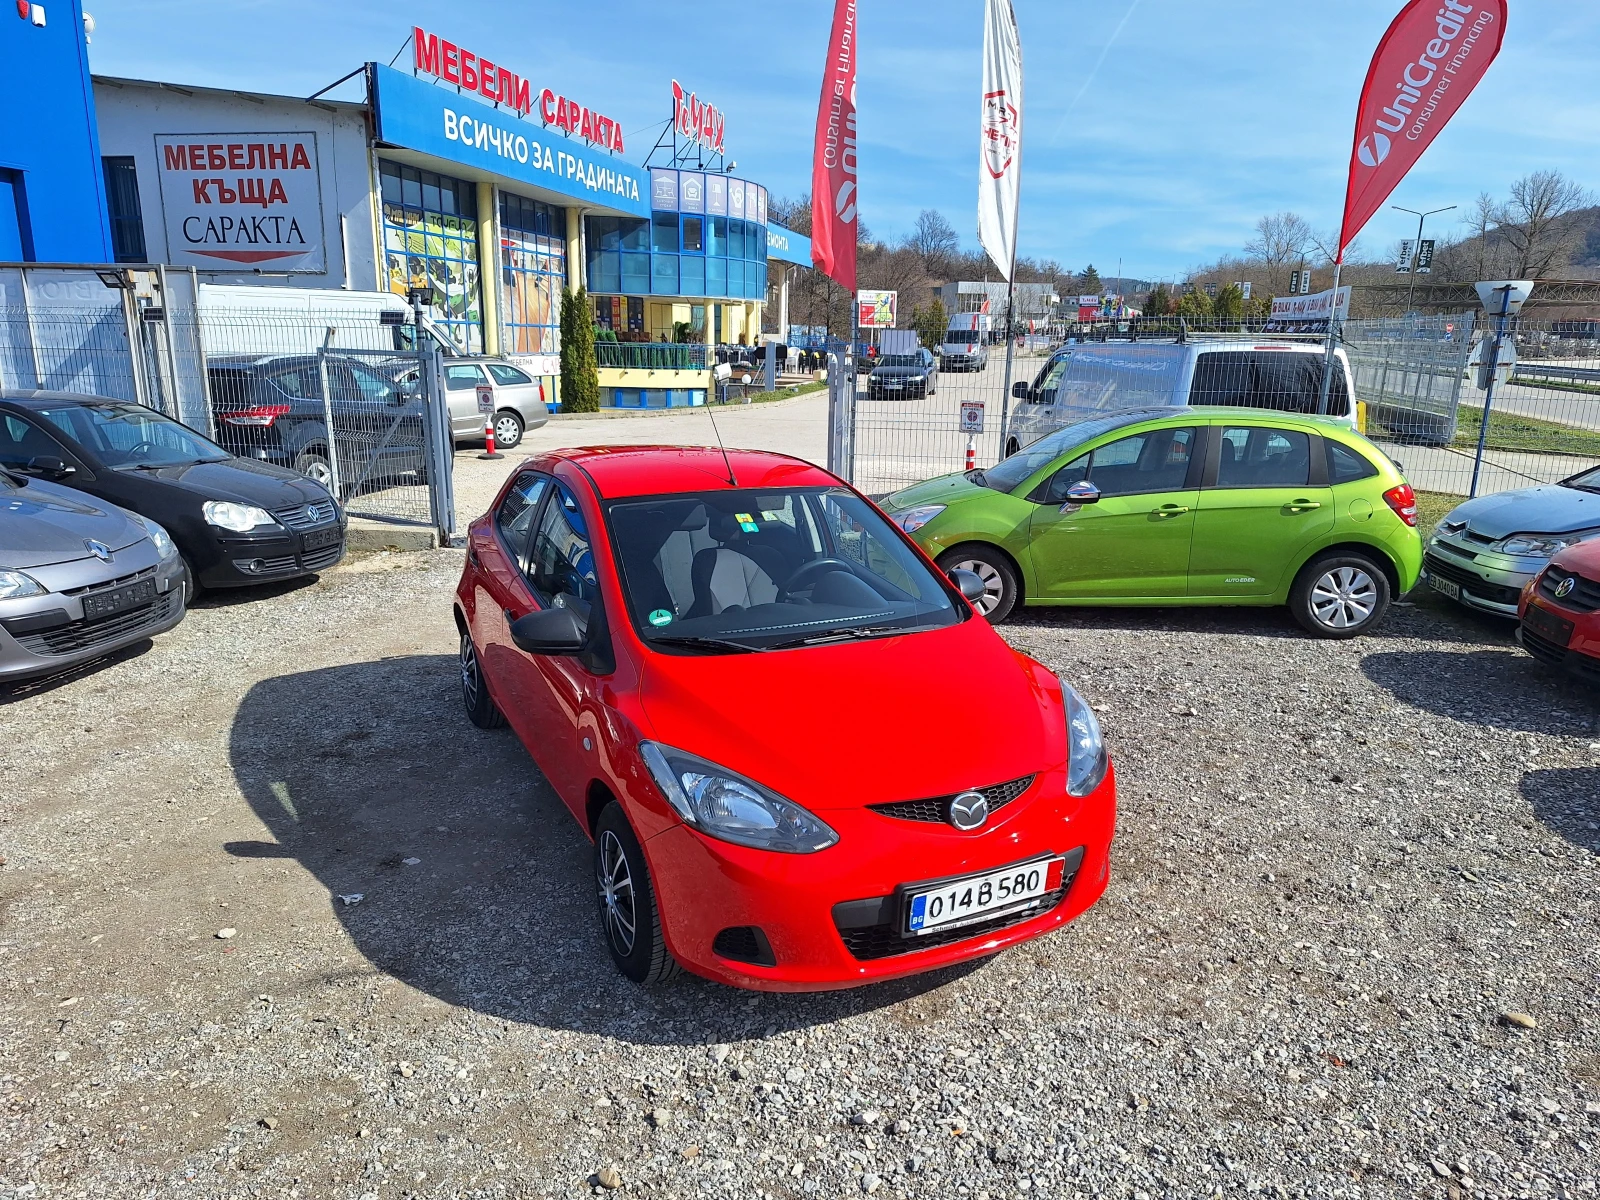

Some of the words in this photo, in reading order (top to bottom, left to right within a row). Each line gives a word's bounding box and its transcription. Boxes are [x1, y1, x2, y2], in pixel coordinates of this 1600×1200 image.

[1376, 0, 1473, 133] UniCredit
[1405, 75, 1453, 141] Consumer
[1444, 10, 1494, 75] Financing
[411, 25, 531, 115] МЕБЕЛИ
[539, 88, 625, 154] САРАКТА
[164, 143, 312, 171] МЕБЕЛНА
[443, 107, 529, 164] ВСИЧКО
[531, 141, 555, 174] ЗА
[557, 152, 640, 202] ГРАДИНАТА
[192, 178, 289, 209] КЪЩА
[182, 215, 307, 245] САРАКТА
[766, 230, 789, 252] ЕМОНТА
[912, 915, 924, 925] BG
